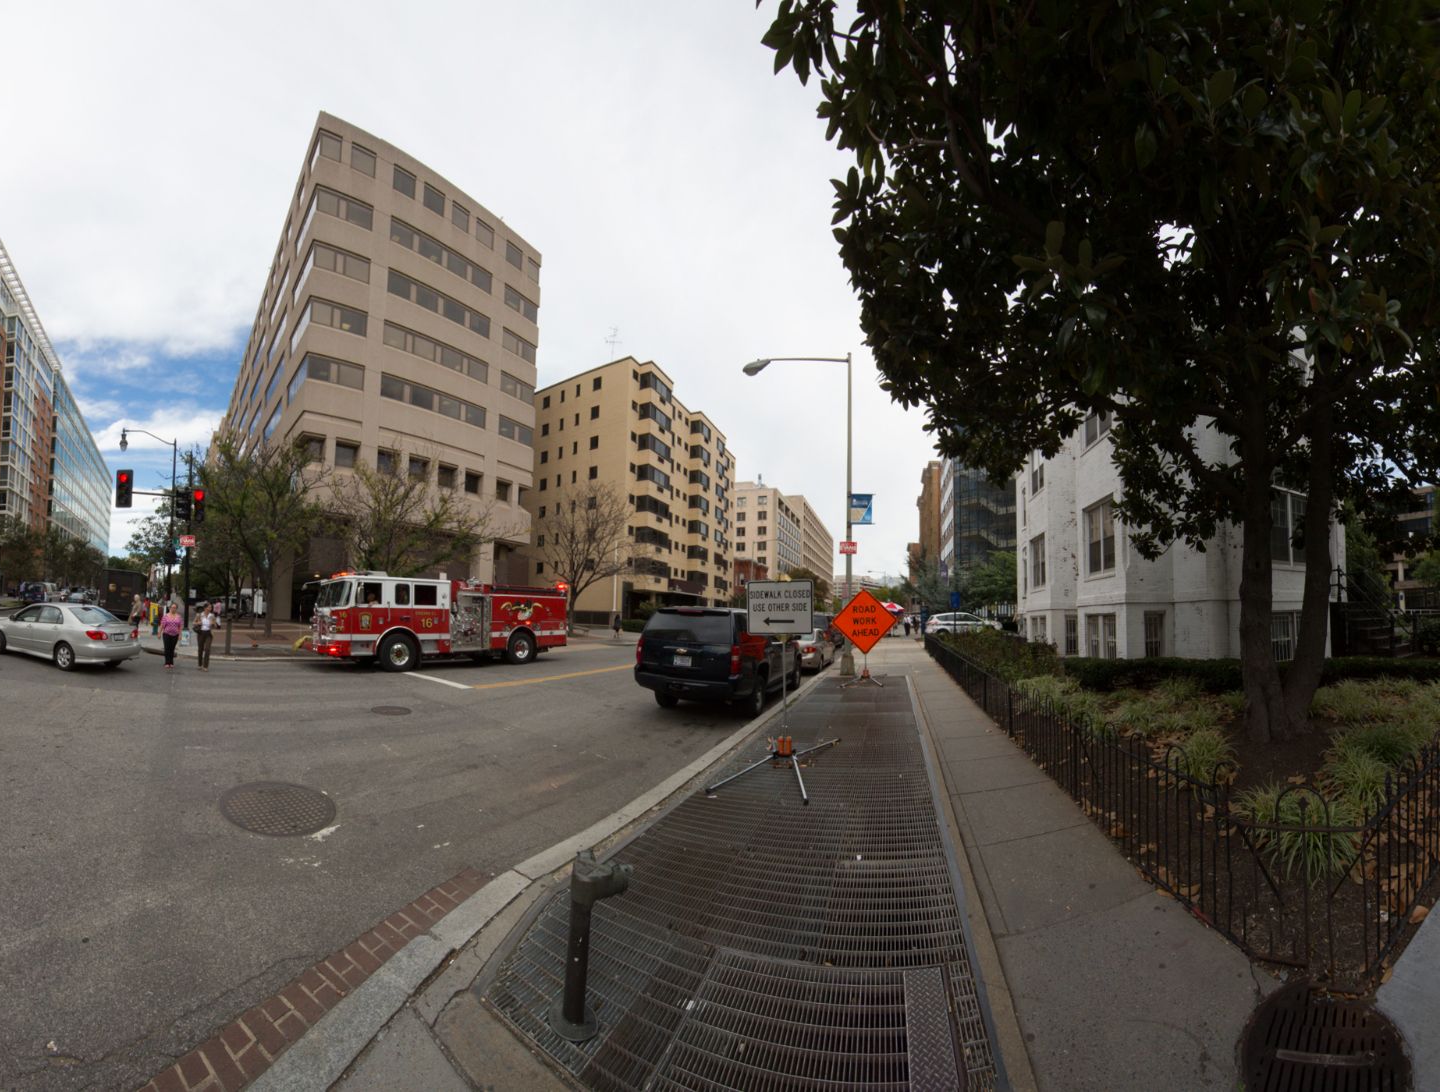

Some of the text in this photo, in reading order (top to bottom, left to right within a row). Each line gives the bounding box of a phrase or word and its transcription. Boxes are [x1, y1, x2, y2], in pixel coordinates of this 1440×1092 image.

[750, 589, 810, 600] SIDEWALK CLOSED
[752, 603, 807, 612] USE OTHER SIDE
[852, 606, 876, 614] ROAD
[421, 617, 433, 628] 16
[852, 617, 877, 625] WORK
[852, 628, 879, 637] AHEAD
